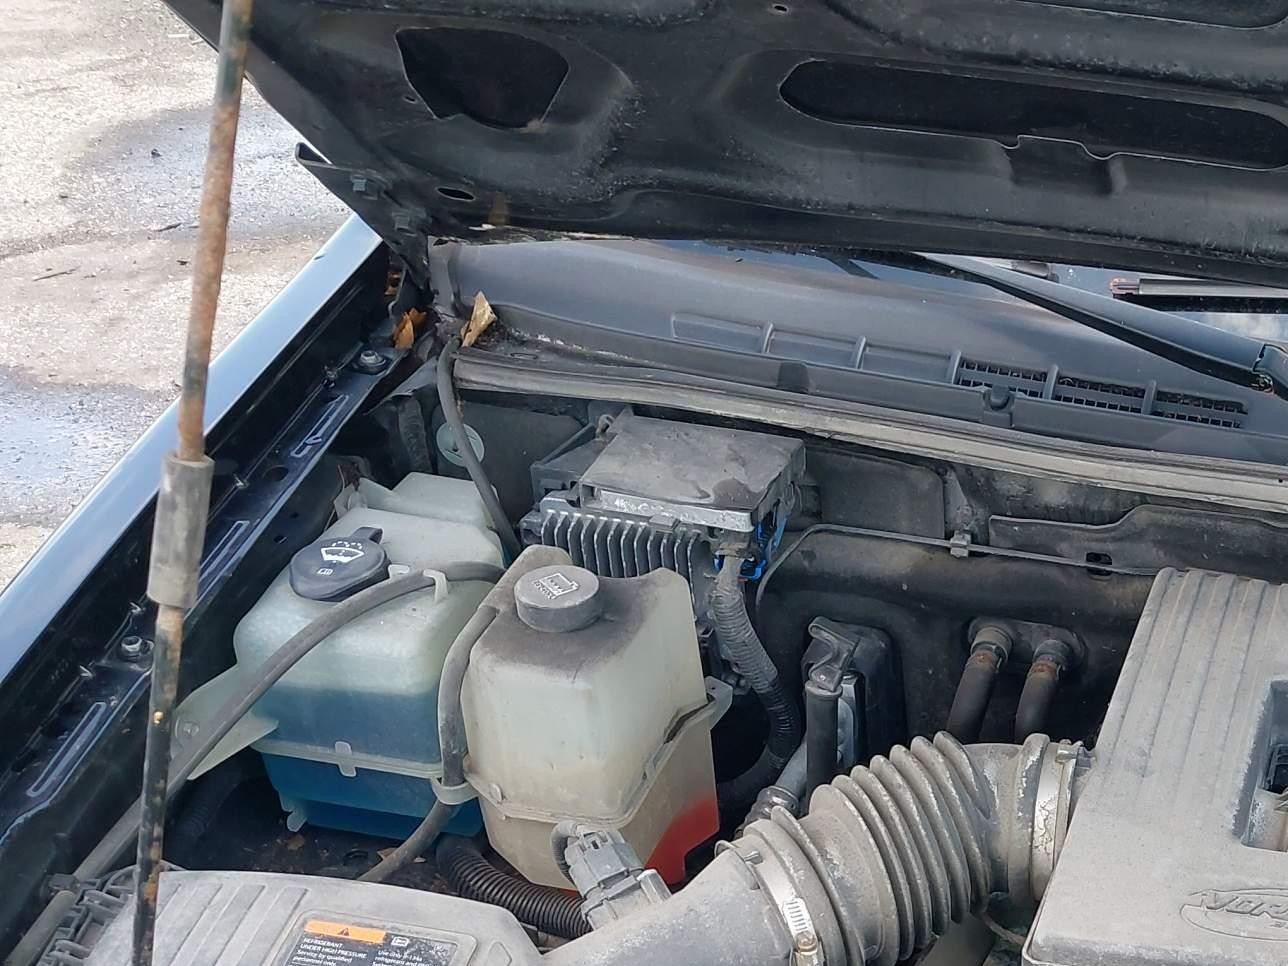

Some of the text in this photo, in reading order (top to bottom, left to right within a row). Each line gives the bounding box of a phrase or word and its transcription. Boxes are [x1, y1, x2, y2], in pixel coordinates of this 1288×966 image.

[302, 938, 344, 948] REFRIGERANT
[299, 943, 322, 951] UNDER
[337, 950, 368, 958] PRESSURE
